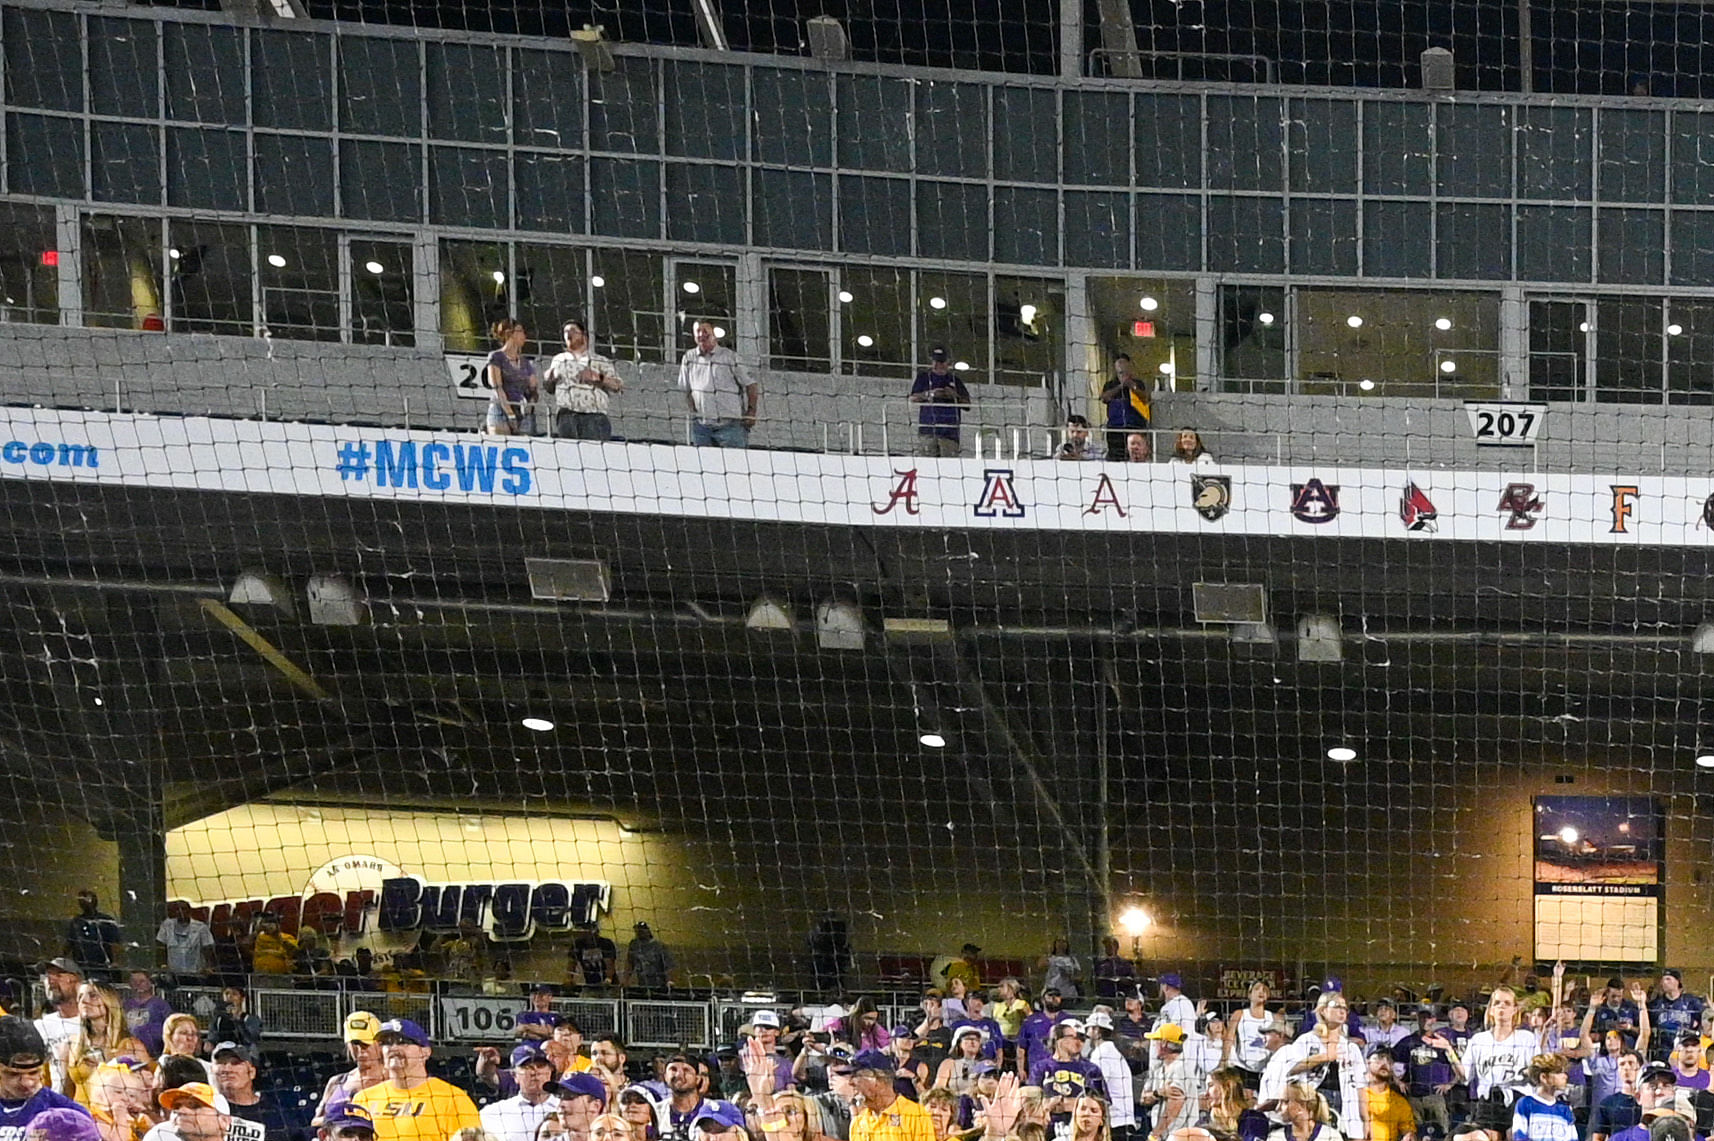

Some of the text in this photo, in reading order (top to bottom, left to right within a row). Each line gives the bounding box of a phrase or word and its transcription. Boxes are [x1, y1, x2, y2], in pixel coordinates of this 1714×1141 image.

[1477, 411, 1535, 437] 207
[336, 438, 531, 496] #MCWS
[1082, 473, 1127, 518] A
[1610, 484, 1639, 534] F
[378, 877, 611, 942] Burger
[1604, 886, 1640, 894] STADIUM
[456, 1006, 515, 1030] 106
